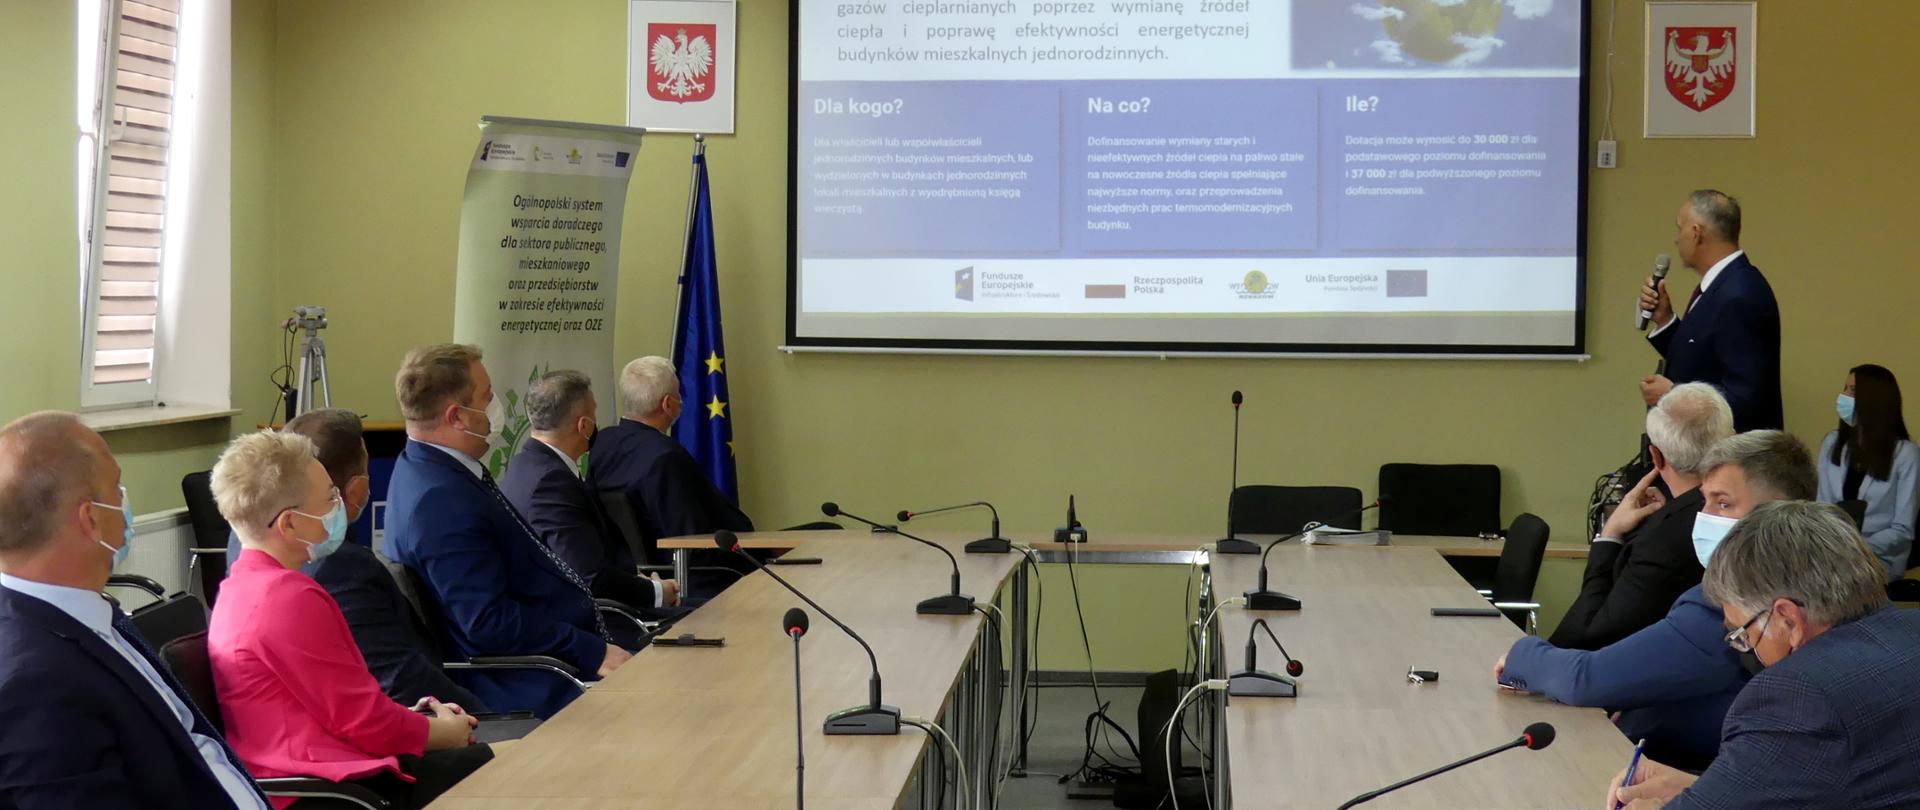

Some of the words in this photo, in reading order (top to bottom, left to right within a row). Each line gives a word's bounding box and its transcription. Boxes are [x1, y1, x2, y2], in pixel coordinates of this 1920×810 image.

[837, 0, 886, 17] gazów
[903, 0, 1016, 16] cieplarnianych
[1033, 2, 1095, 15] poprzez
[1112, 0, 1184, 15] wymianę
[838, 24, 883, 40] ciepła
[903, 24, 907, 38] i
[927, 26, 996, 40] poprawę
[1015, 22, 1119, 39] efektywności
[1138, 22, 1249, 39] energetycznej
[838, 47, 919, 63] budynków
[924, 46, 1027, 63] mieszkalnych
[1032, 46, 1169, 63] jednorodzinnych.
[814, 98, 844, 114] Dla
[849, 98, 903, 118] kogo?
[1088, 98, 1113, 113] Na
[1118, 97, 1151, 113] co?
[1346, 95, 1379, 112] Ile?
[885, 136, 900, 147] lub
[1088, 136, 1166, 146] Dofinansowanie
[1168, 136, 1212, 148] wymiany
[1214, 136, 1250, 148] starych
[1345, 135, 1384, 147] Dotacja
[1386, 134, 1413, 145] może
[1415, 134, 1455, 147] wynosić
[1458, 134, 1471, 145] do
[1473, 134, 1487, 145] 30
[1489, 134, 1509, 145] 000
[1510, 134, 1520, 144] zł
[1521, 134, 1537, 144] dla
[896, 153, 944, 165] budynków
[1018, 153, 1033, 163] lub
[1088, 153, 1163, 165] nieefektywnych
[1198, 152, 1228, 165] ciepła
[1230, 154, 1242, 163] na
[1244, 152, 1278, 165] paliwo
[1345, 151, 1421, 163] podstawowego
[1423, 151, 1466, 162] poziomu
[1468, 150, 1546, 161] dofinansowania
[881, 172, 890, 180] w
[892, 170, 944, 182] budynkach
[946, 169, 1028, 182] jednorodzinnych
[1088, 171, 1100, 180] na
[1102, 171, 1163, 180] nowoczesne
[1199, 168, 1229, 181] ciepła
[1231, 168, 1287, 181] spełniające
[1351, 168, 1364, 179] 37
[1366, 168, 1386, 179] 000
[1388, 168, 1397, 178] zł
[1399, 168, 1414, 178] dla
[1416, 167, 1496, 180] podwyższonego
[1498, 167, 1541, 179] poziomu
[918, 187, 987, 200] wyodrębnioną
[1088, 185, 1138, 198] najwyższe
[1140, 187, 1173, 198] normy,
[1175, 187, 1197, 196] oraz
[1199, 185, 1283, 198] przeprowadzenia
[1345, 185, 1425, 196] dofinansowania.
[513, 194, 571, 211] Ogólnopolski
[572, 197, 603, 212] system
[1088, 202, 1149, 214] niezbędnych
[1151, 204, 1173, 214] prac
[1175, 201, 1293, 214] termomodernizacyjnych
[511, 216, 550, 231] wsparcia
[552, 217, 603, 234] doradczego
[1088, 219, 1132, 231] budynku.
[501, 236, 517, 248] dla
[519, 237, 551, 250] sektora
[553, 238, 607, 254] publicznego,
[519, 257, 590, 273] mieszkaniowego
[981, 272, 1024, 281] Fundusze
[1134, 276, 1203, 286] Rzeczpospolita
[1305, 274, 1326, 283] Unia
[1327, 273, 1379, 284] Europejska
[508, 279, 526, 290] oraz
[528, 277, 599, 293] przedsiębiorstw
[981, 280, 1035, 291] Europejskie
[1134, 285, 1165, 294] Polska
[499, 300, 507, 310] w
[510, 298, 544, 311] zakresie
[546, 298, 604, 313] efektywności
[501, 318, 562, 334] energetycznej
[563, 320, 582, 331] oraz
[585, 318, 603, 331] OZE
